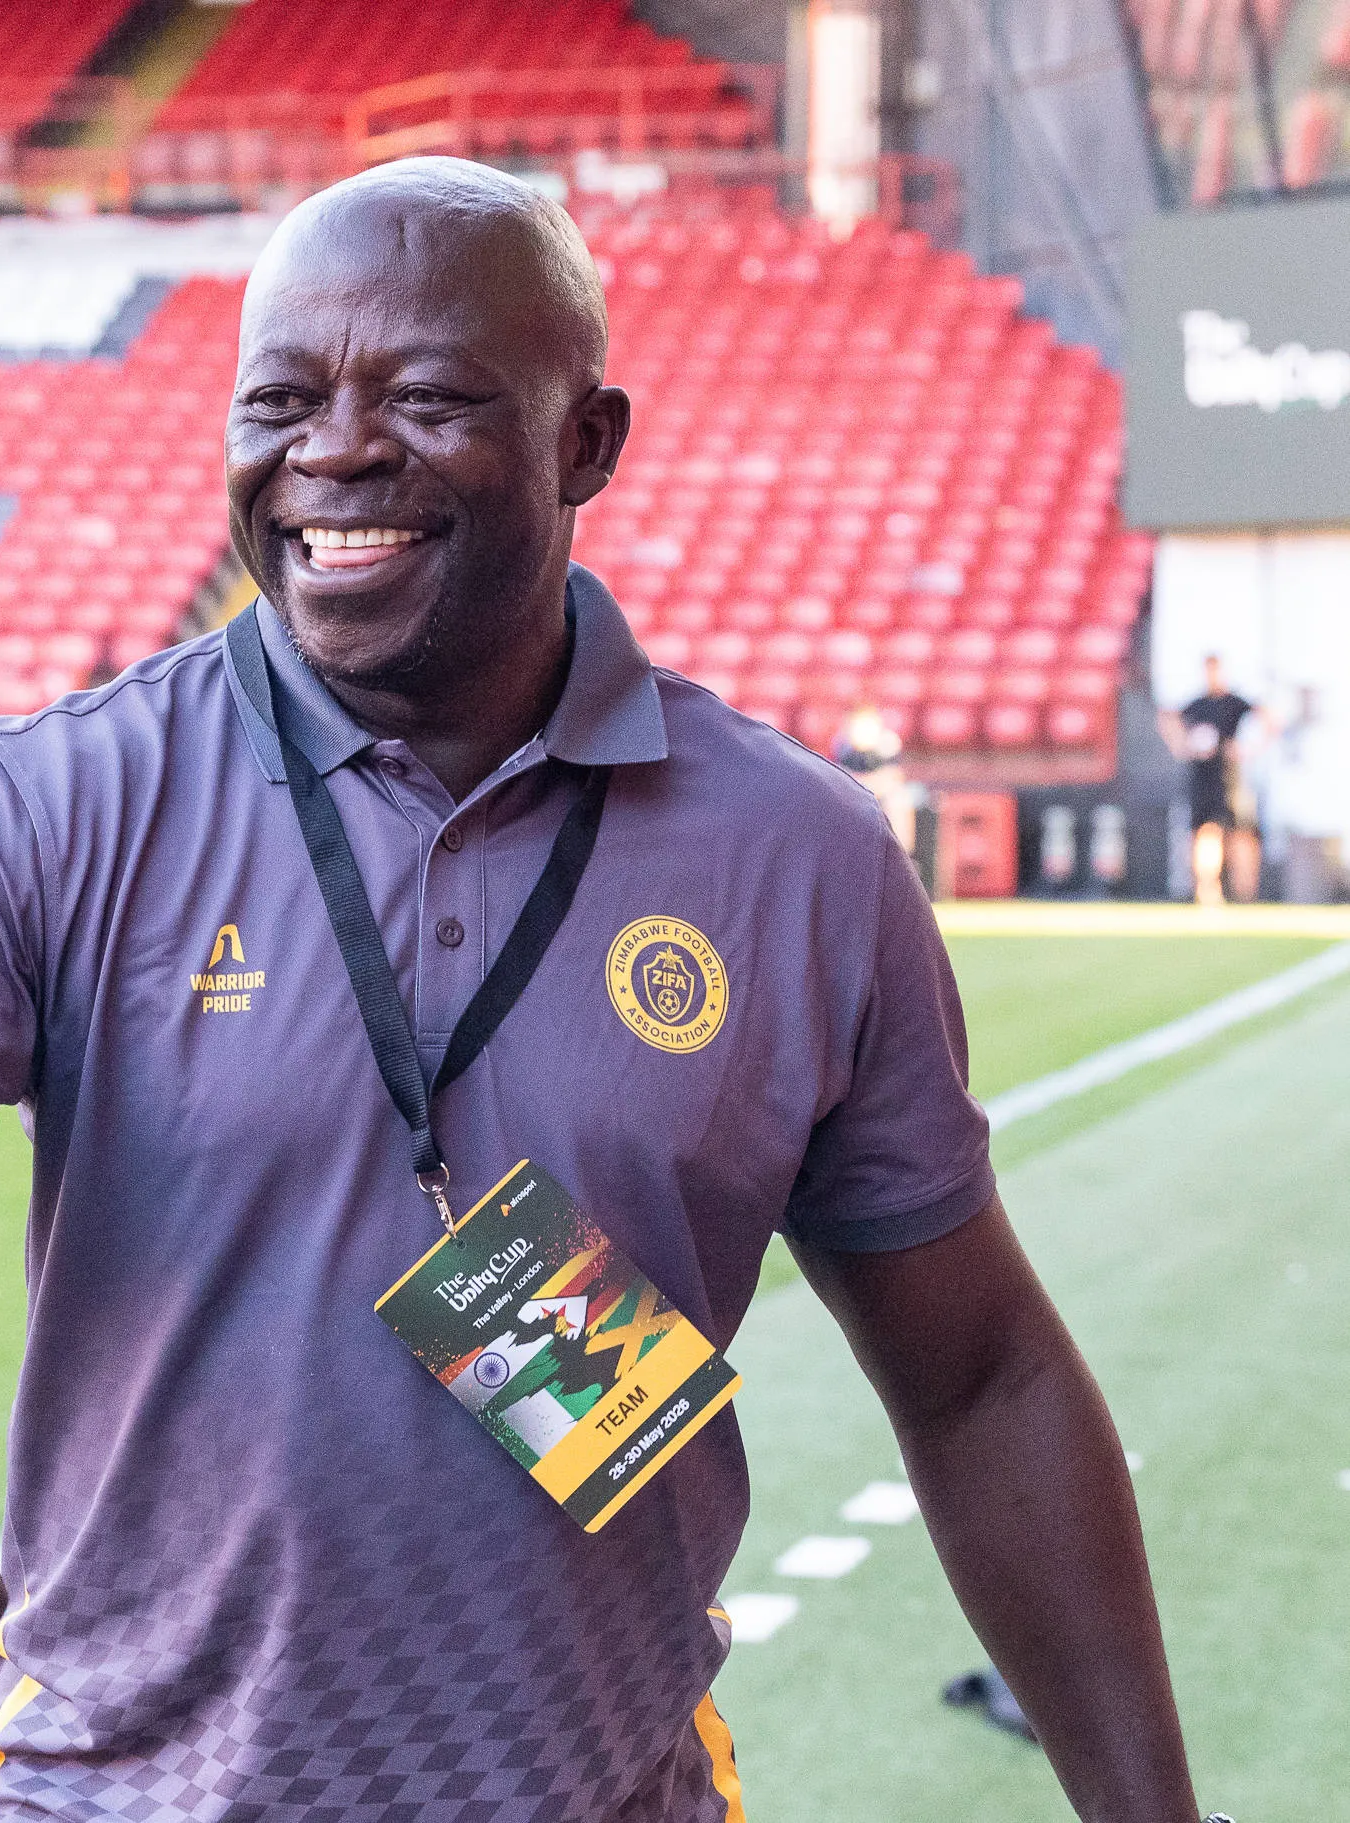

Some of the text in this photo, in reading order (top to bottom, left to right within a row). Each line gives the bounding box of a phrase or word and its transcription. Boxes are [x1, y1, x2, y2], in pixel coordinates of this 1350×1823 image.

[615, 925, 720, 991] ZIMBABWE FOOTBALL
[651, 969, 687, 991] ZIFA
[190, 970, 266, 992] WARRIOR
[202, 993, 252, 1014] PRIDE
[626, 1007, 710, 1044] ASSOCIATION
[432, 1272, 467, 1301] The
[447, 1237, 534, 1312] Unity Cup
[472, 1312, 491, 1329] The
[487, 1290, 513, 1315] Valley
[513, 1260, 544, 1290] London
[595, 1384, 649, 1436] TEAM
[608, 1398, 690, 1481] 26-30 May 2026
